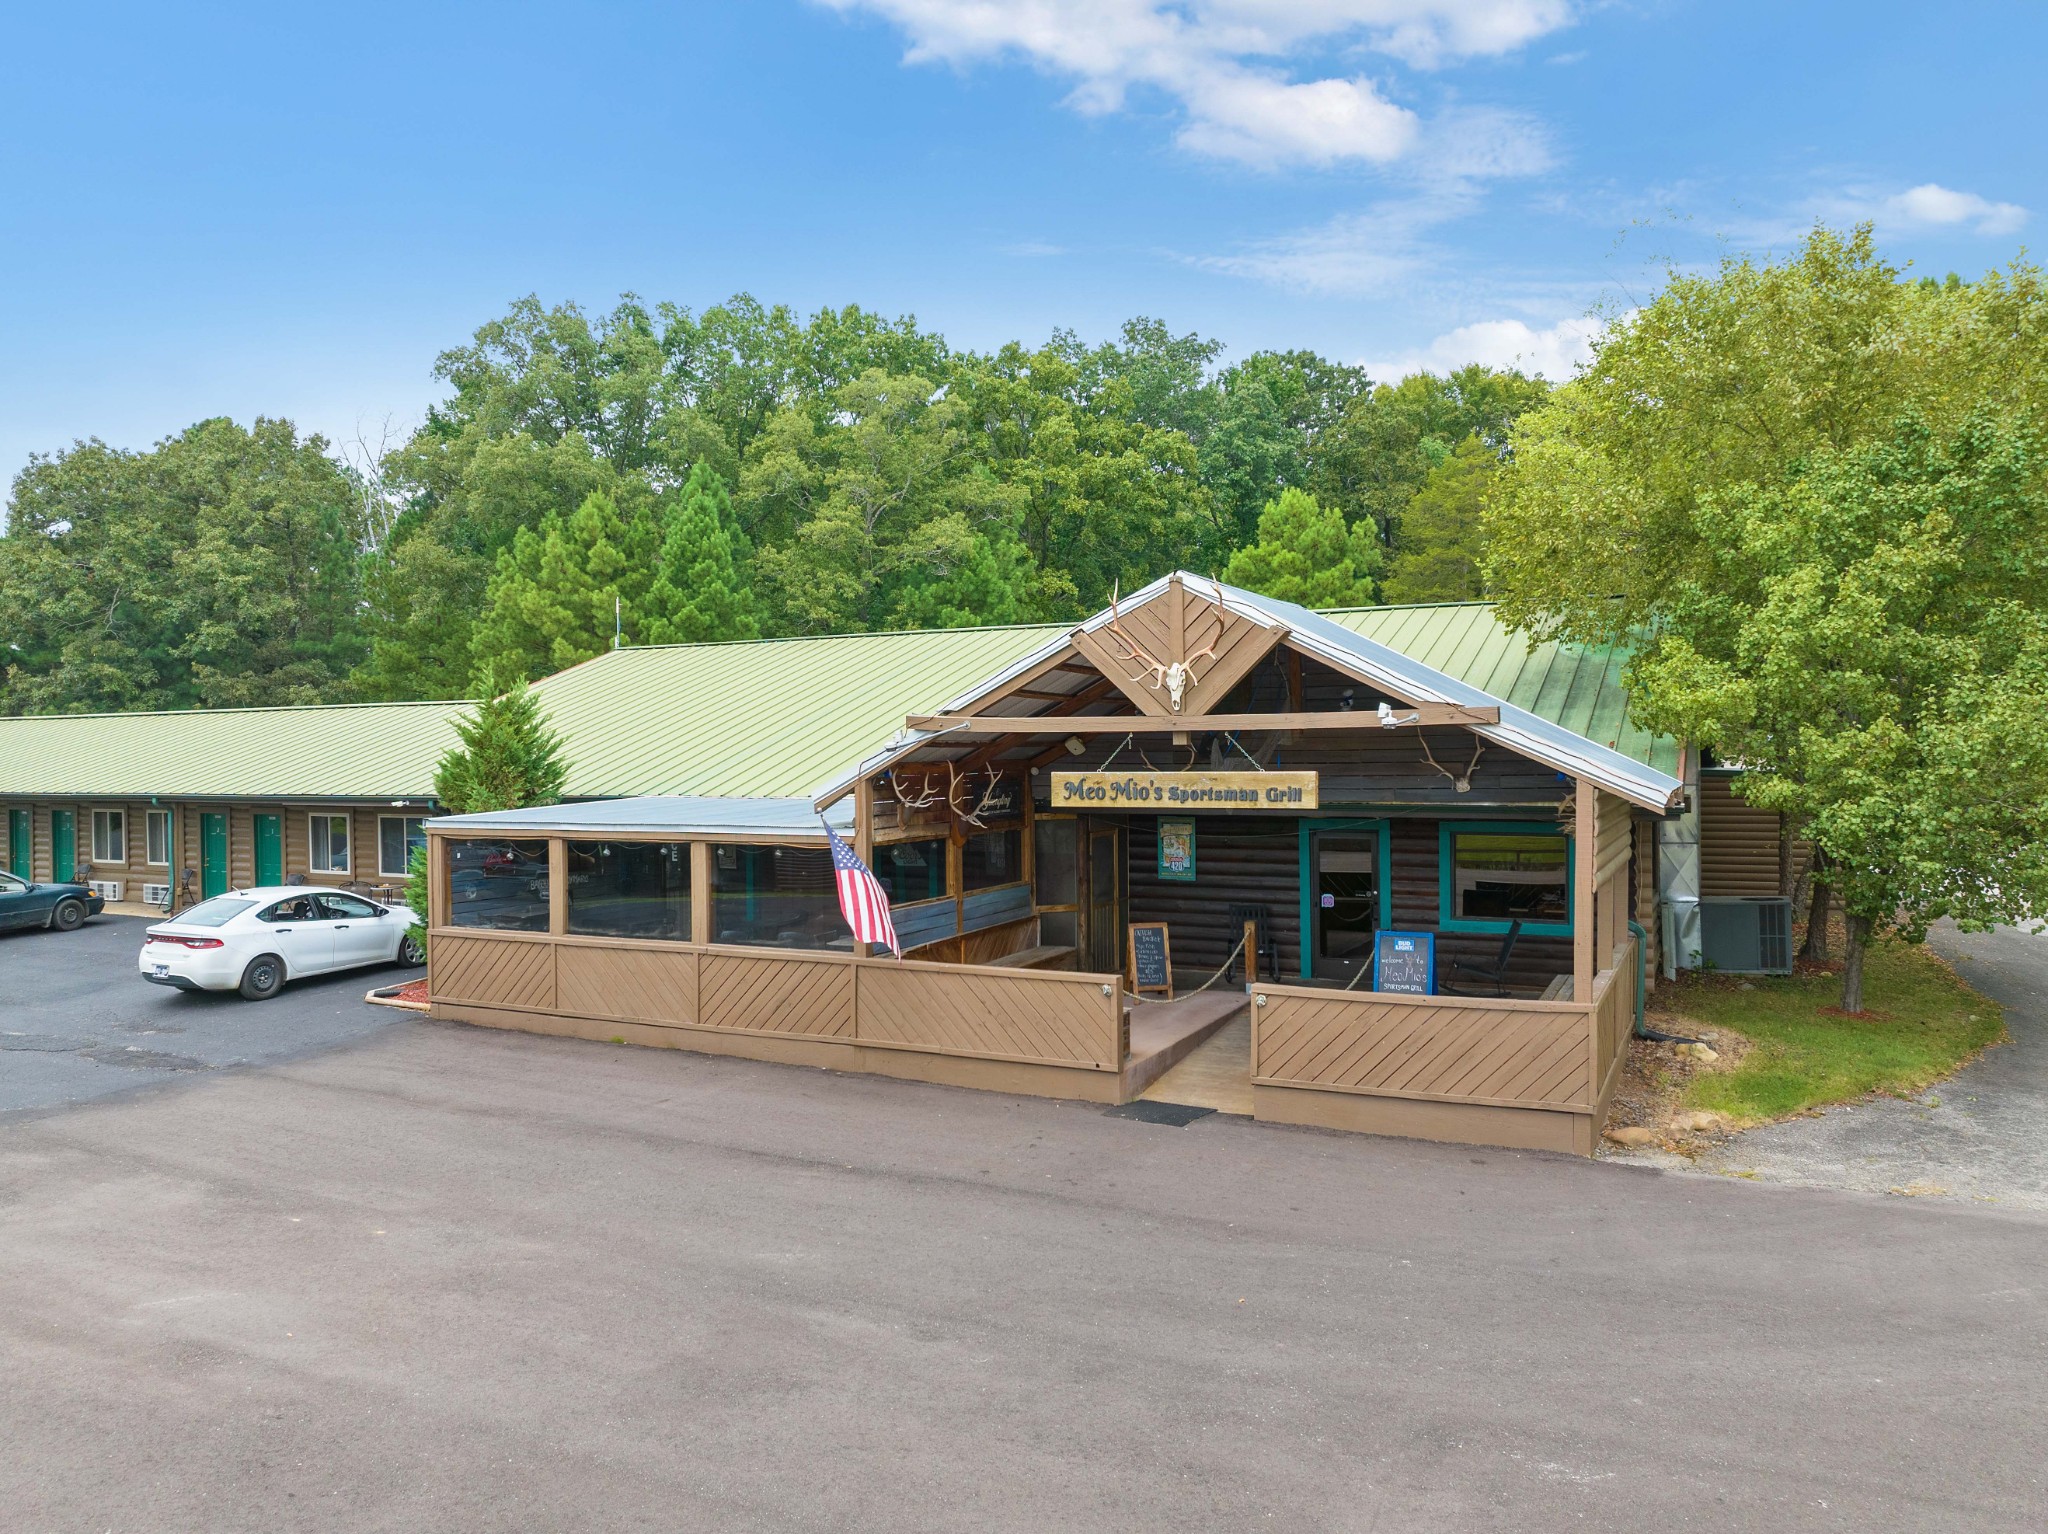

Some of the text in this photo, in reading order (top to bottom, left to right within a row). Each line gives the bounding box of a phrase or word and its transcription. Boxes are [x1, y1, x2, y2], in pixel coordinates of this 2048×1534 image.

[1110, 778, 1163, 801] Mio's
[1168, 785, 1258, 804] Sportsman
[1265, 786, 1302, 803] Grill
[1170, 862, 1182, 871] 420
[1416, 955, 1424, 964] to
